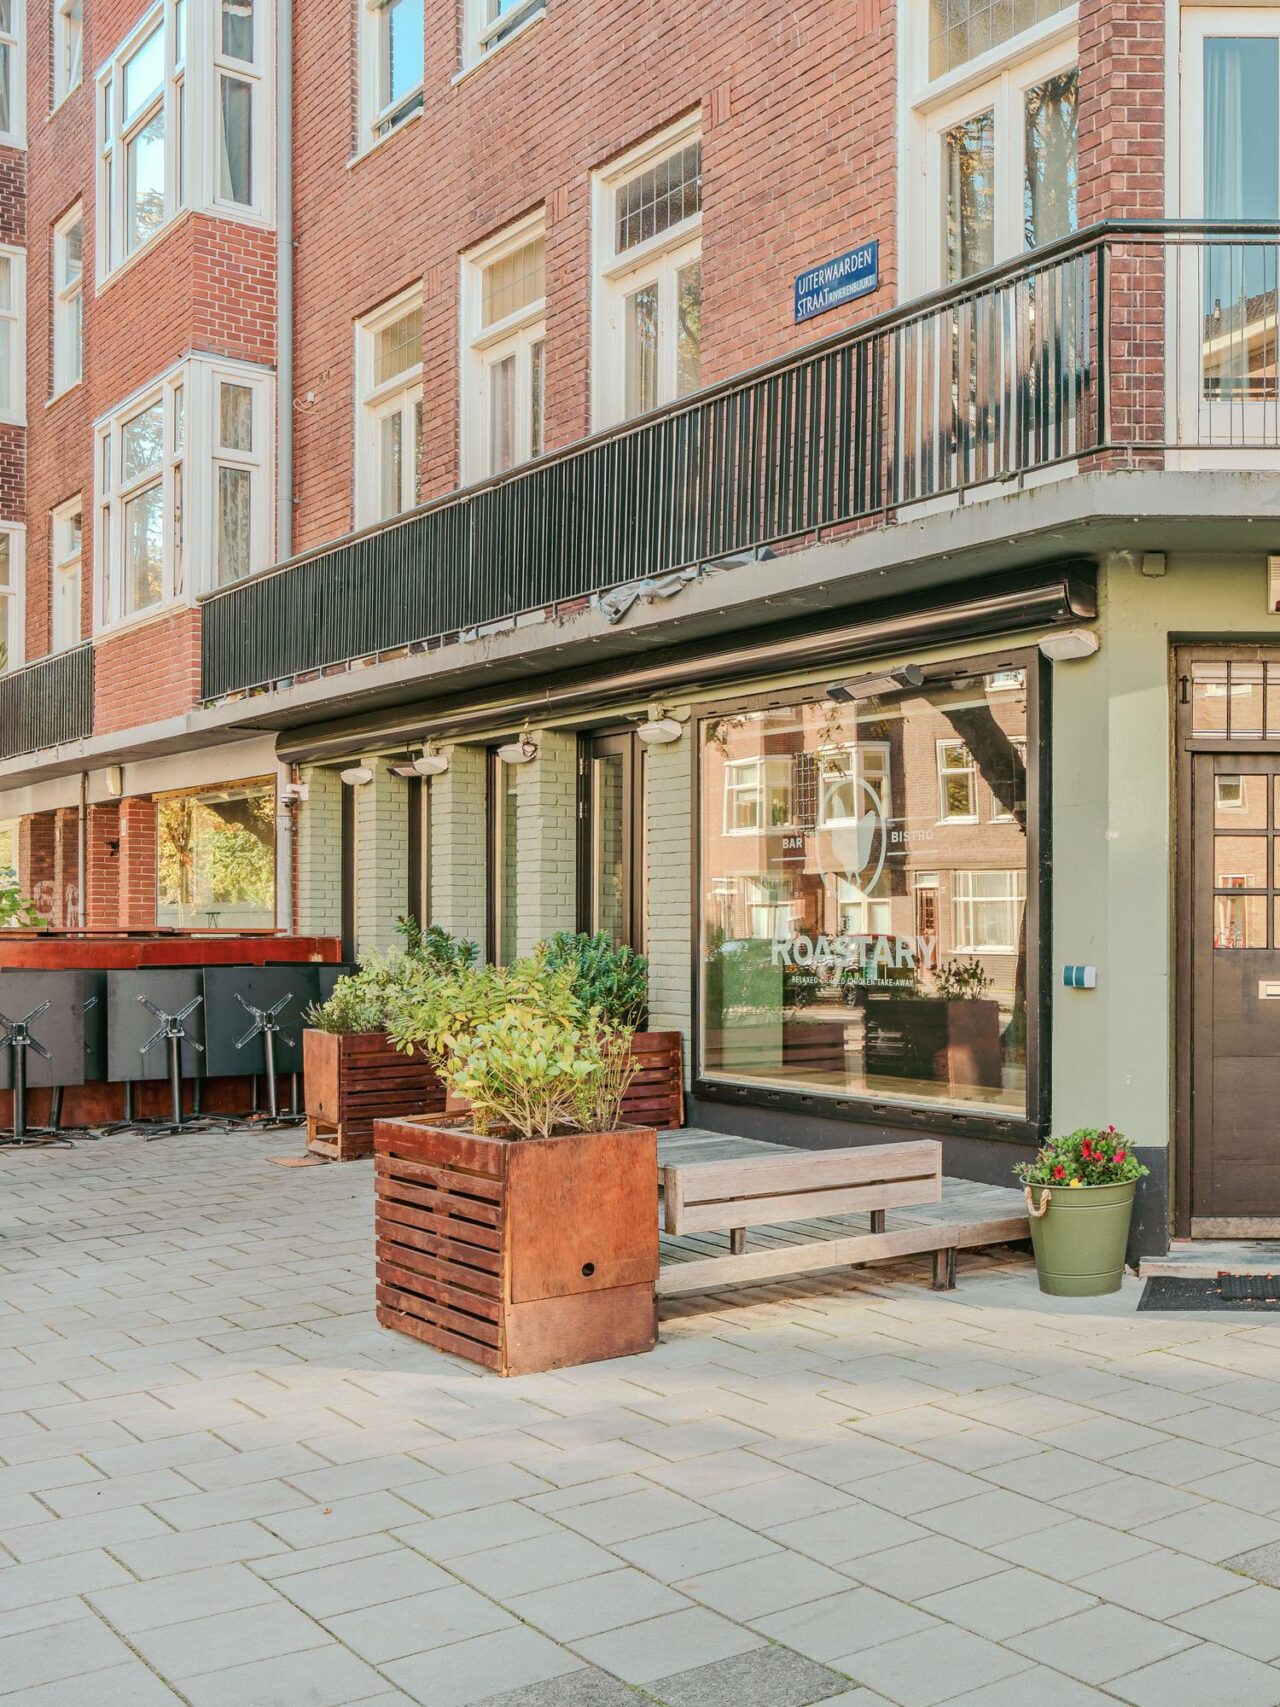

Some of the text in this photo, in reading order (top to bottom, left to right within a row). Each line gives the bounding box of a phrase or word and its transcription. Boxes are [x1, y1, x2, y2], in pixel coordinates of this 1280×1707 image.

[798, 247, 872, 295] UITERWAARDEN
[797, 288, 829, 317] STRAAT
[782, 837, 803, 849] BAR
[891, 829, 934, 843] BISTRO
[771, 935, 937, 968] ROASTARY
[791, 975, 817, 984] RELAXED
[877, 978, 913, 987] TAKE-AWAY
